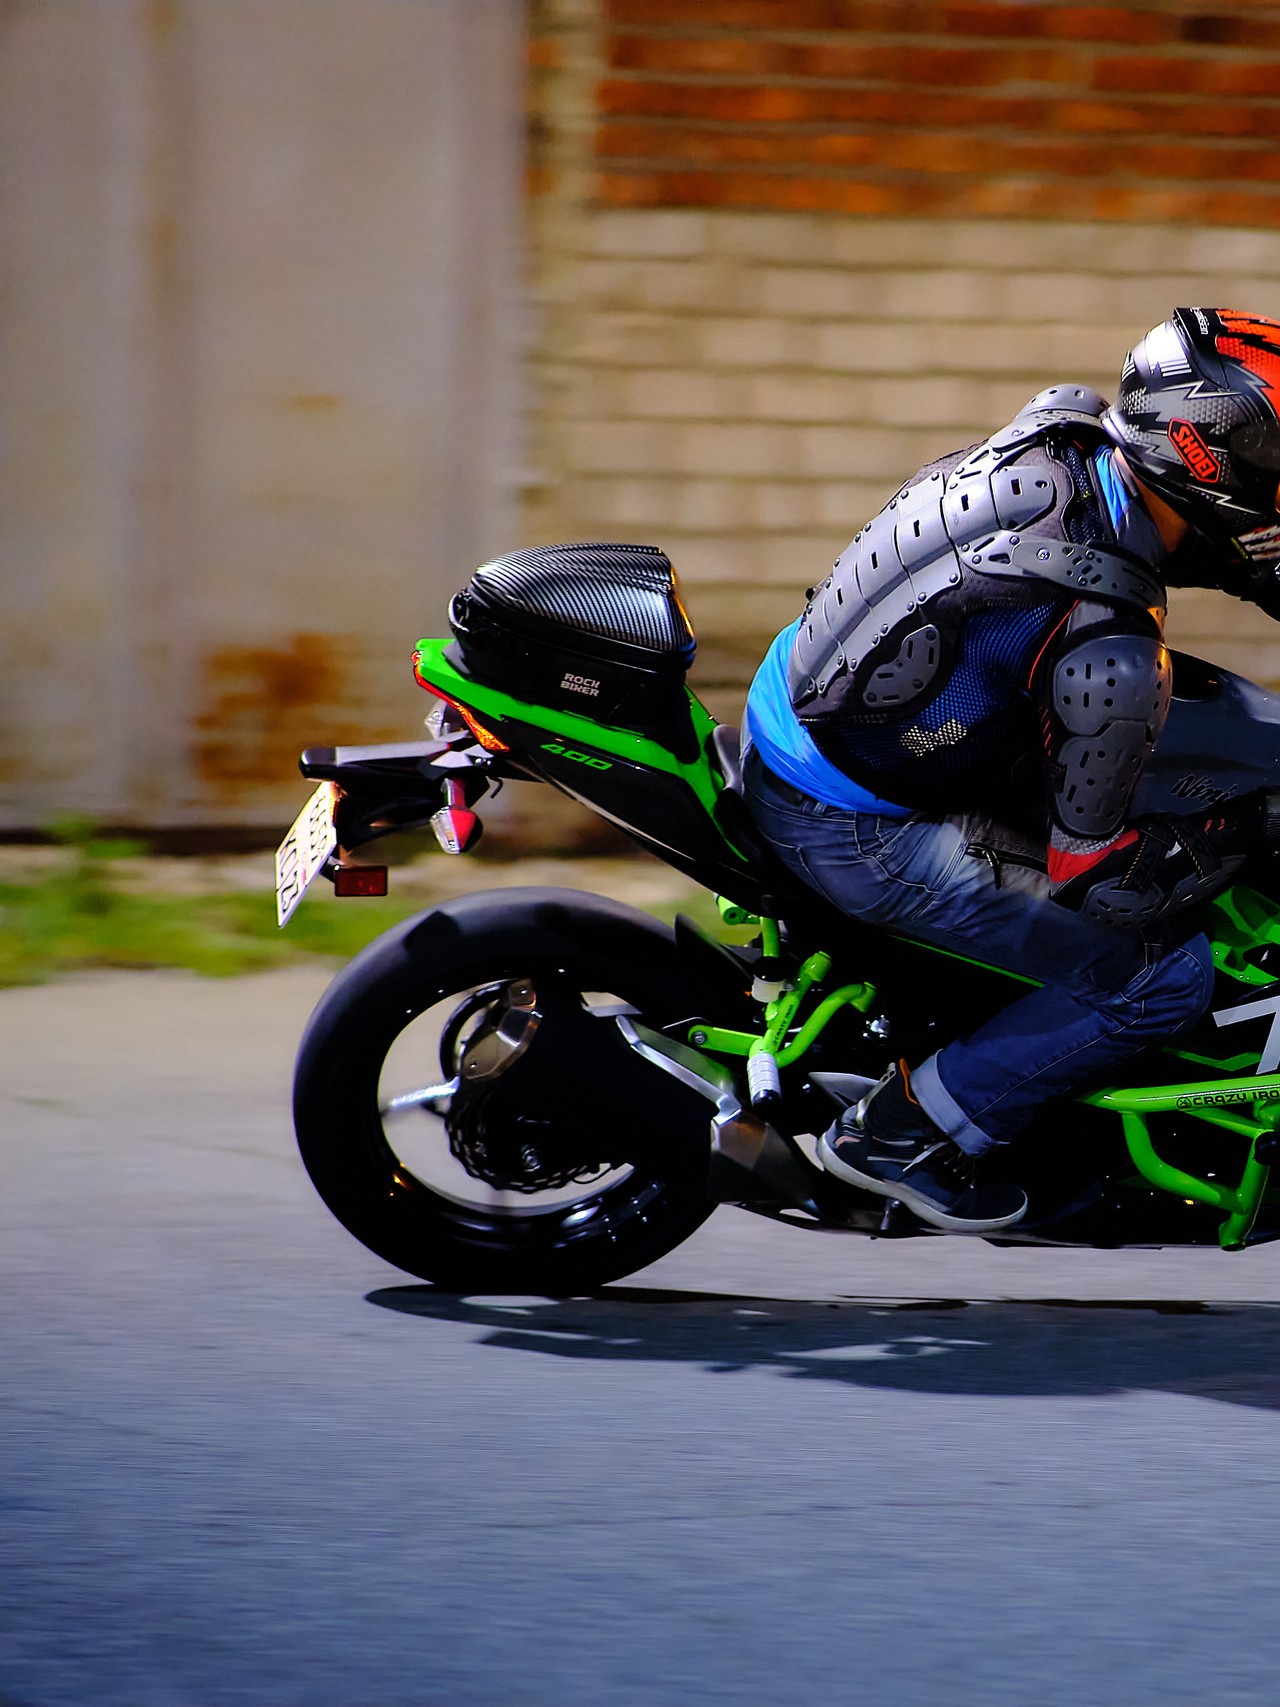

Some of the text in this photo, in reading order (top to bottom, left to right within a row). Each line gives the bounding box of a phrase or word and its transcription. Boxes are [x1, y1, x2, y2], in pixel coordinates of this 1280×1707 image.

[1173, 425, 1216, 478] SHOEI
[564, 673, 601, 688] ROCK
[560, 681, 600, 696] BIKER
[540, 744, 613, 770] 400
[1193, 1092, 1247, 1106] CRAZY
